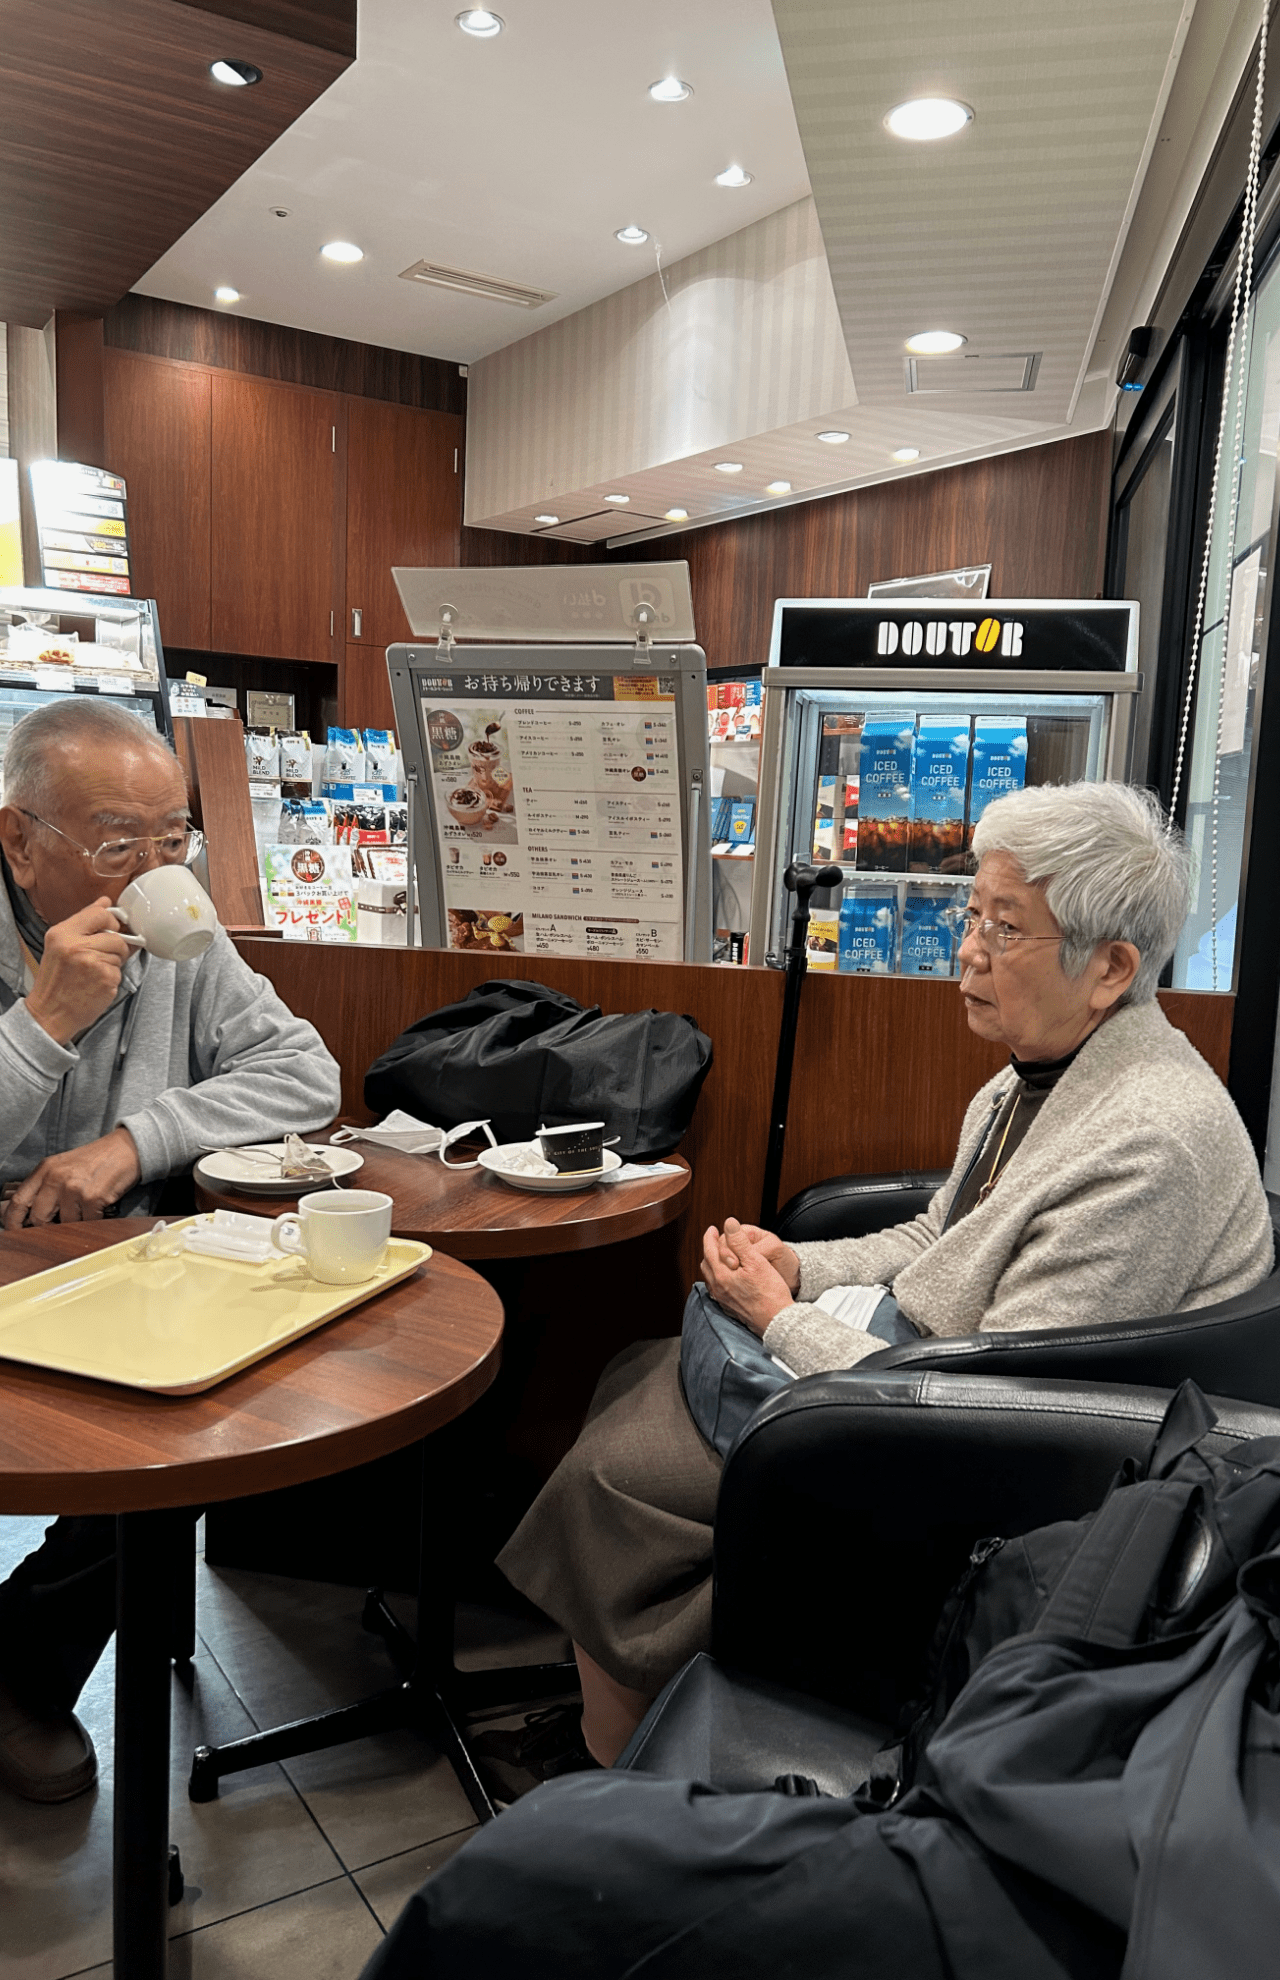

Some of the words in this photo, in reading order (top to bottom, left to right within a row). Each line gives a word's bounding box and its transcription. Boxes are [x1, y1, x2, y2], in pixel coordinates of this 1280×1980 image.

[878, 618, 1024, 656] DOUTOR
[422, 678, 453, 686] DOUTOR
[464, 675, 600, 692] お持ち帰りできます
[874, 761, 898, 771] ICED
[930, 765, 953, 774] ICED
[987, 767, 1011, 777] ICED
[866, 774, 905, 783] COFFEE
[921, 777, 960, 786] COFFEE
[979, 779, 1018, 789] COFFEE
[276, 909, 351, 925] プレゼント!
[651, 929, 657, 937] B
[852, 938, 876, 947] ICED
[916, 936, 939, 945] ICED
[844, 950, 883, 959] COFFEE
[907, 947, 946, 957] COFFEE
